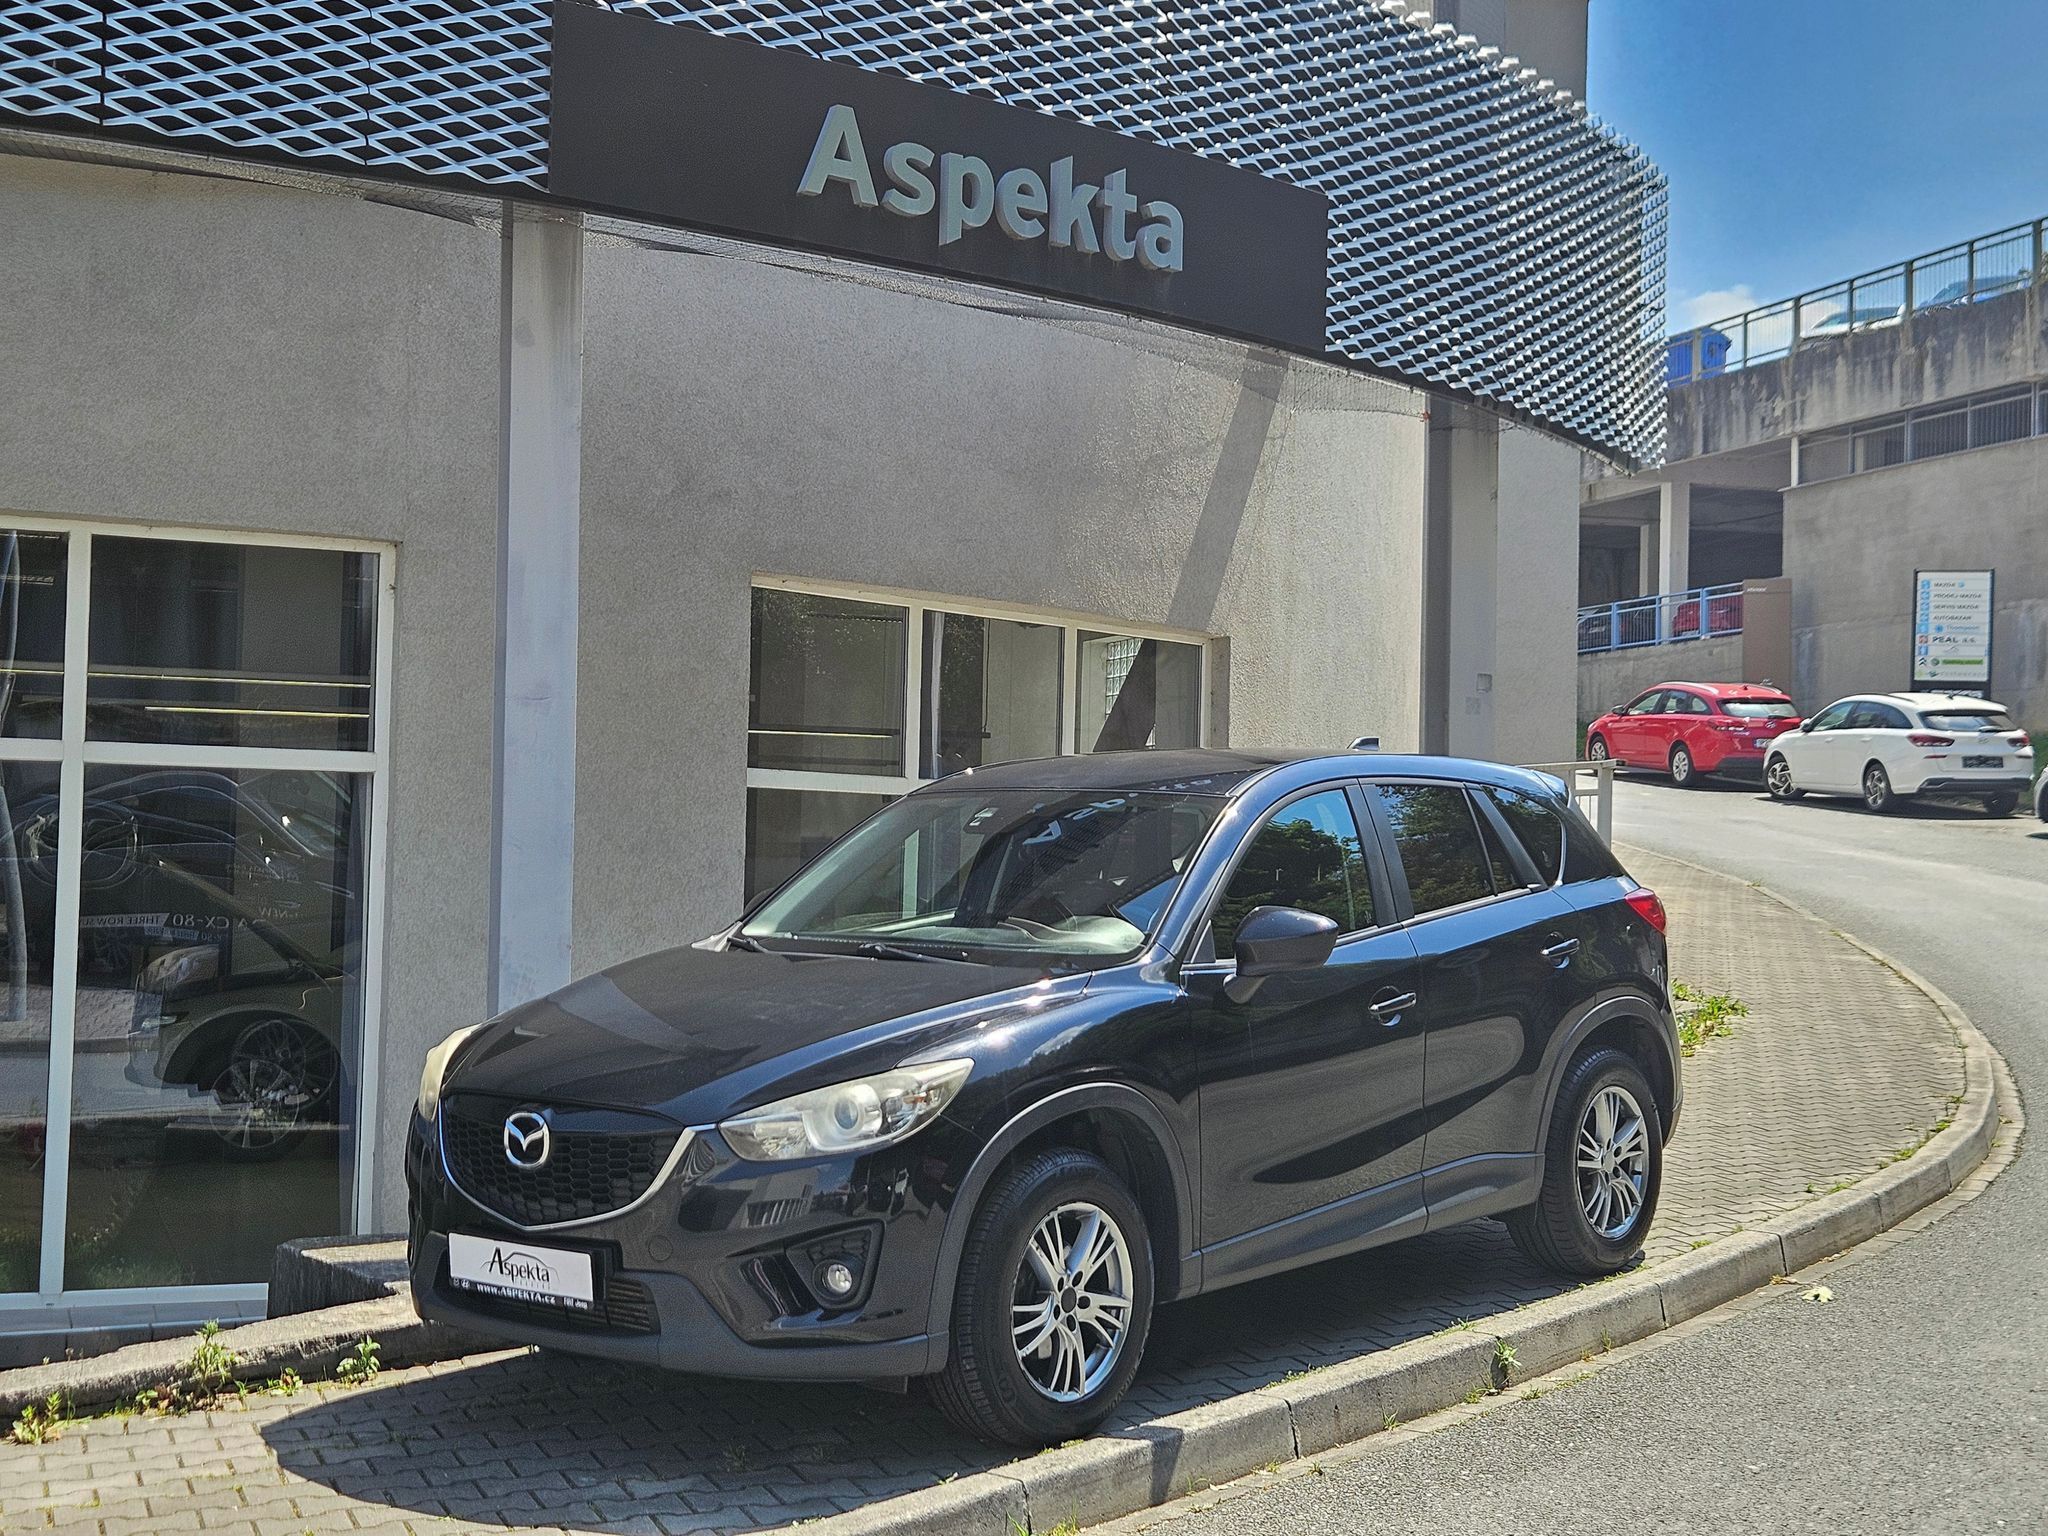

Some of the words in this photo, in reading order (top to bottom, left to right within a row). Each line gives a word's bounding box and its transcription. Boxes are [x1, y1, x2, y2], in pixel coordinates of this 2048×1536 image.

[796, 103, 1184, 273] Aspekta
[489, 1246, 550, 1283] Aspekta
[476, 1283, 556, 1305] www.ASPEKTA.cz
